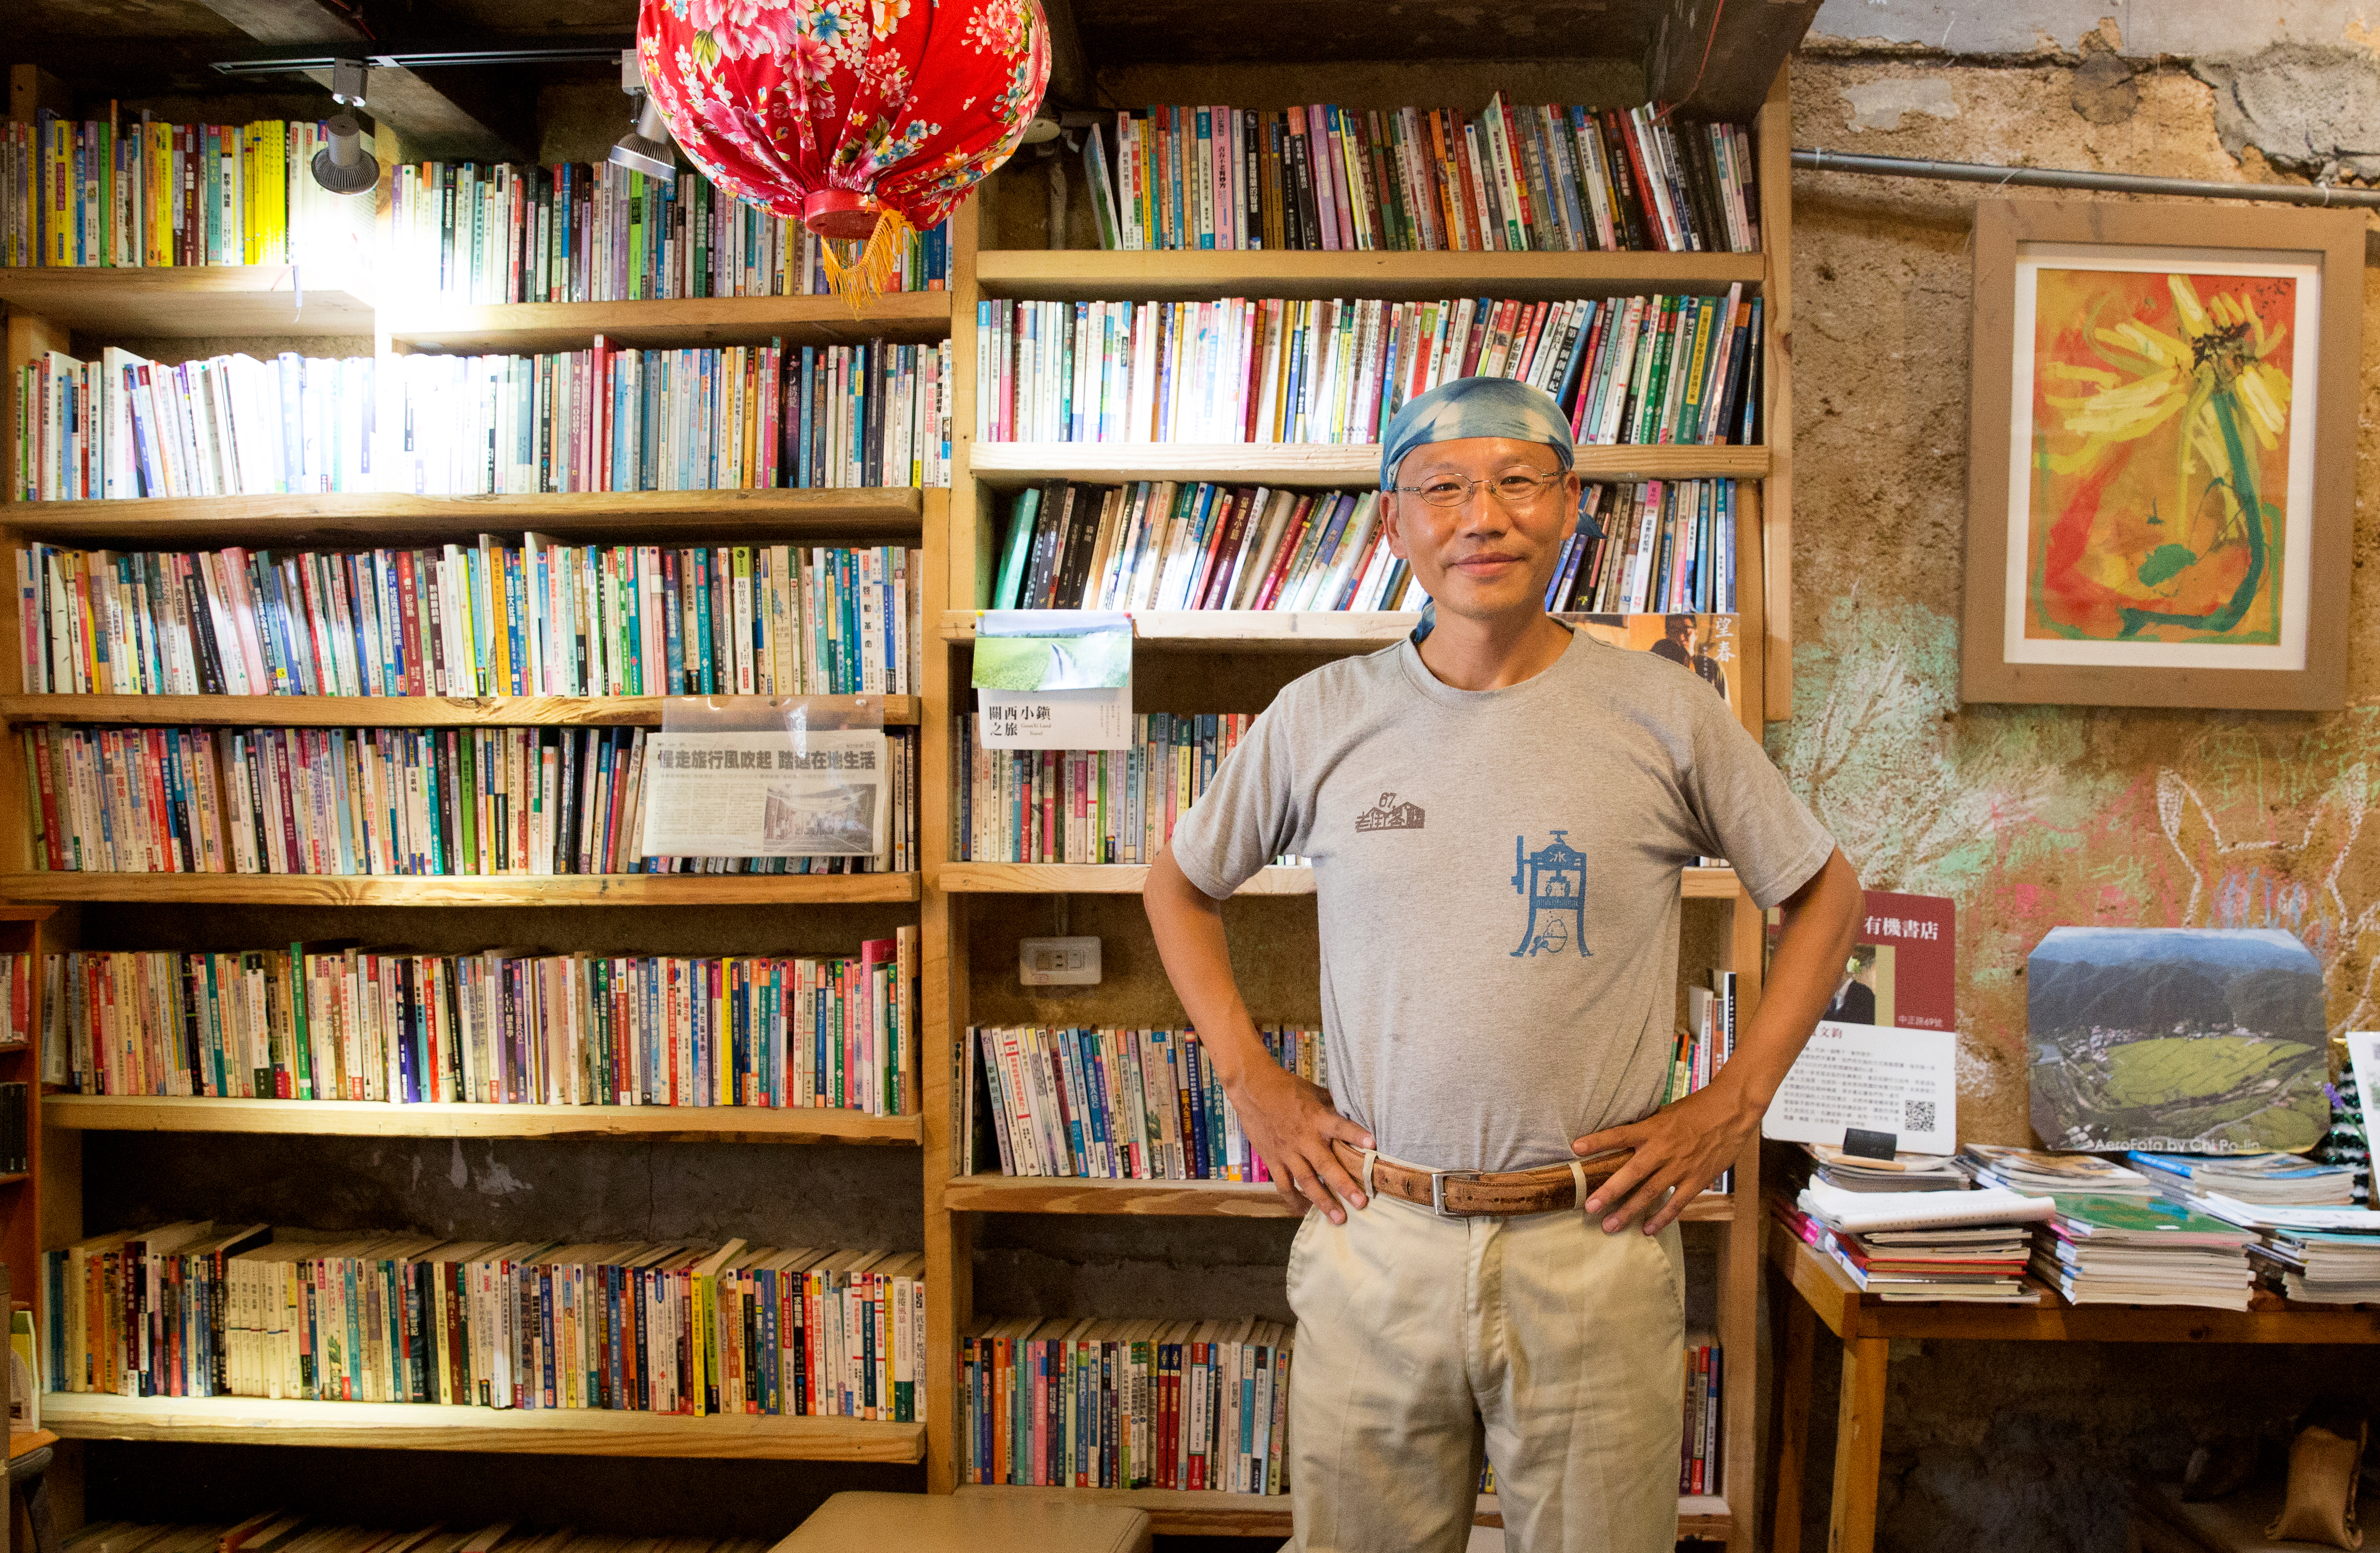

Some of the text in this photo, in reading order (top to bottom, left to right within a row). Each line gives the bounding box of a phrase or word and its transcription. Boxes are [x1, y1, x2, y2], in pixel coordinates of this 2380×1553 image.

[737, 580, 747, 615] 精實革命
[1715, 617, 1736, 662] 望春
[989, 705, 1051, 720] 關西小鎮
[990, 722, 1018, 736] 之旅
[1549, 851, 1567, 864] 冰
[1864, 915, 1939, 941] 有機書店
[2094, 1138, 2165, 1152] AeroFoto
[2166, 1138, 2187, 1153] by
[2189, 1138, 2218, 1152] Chi
